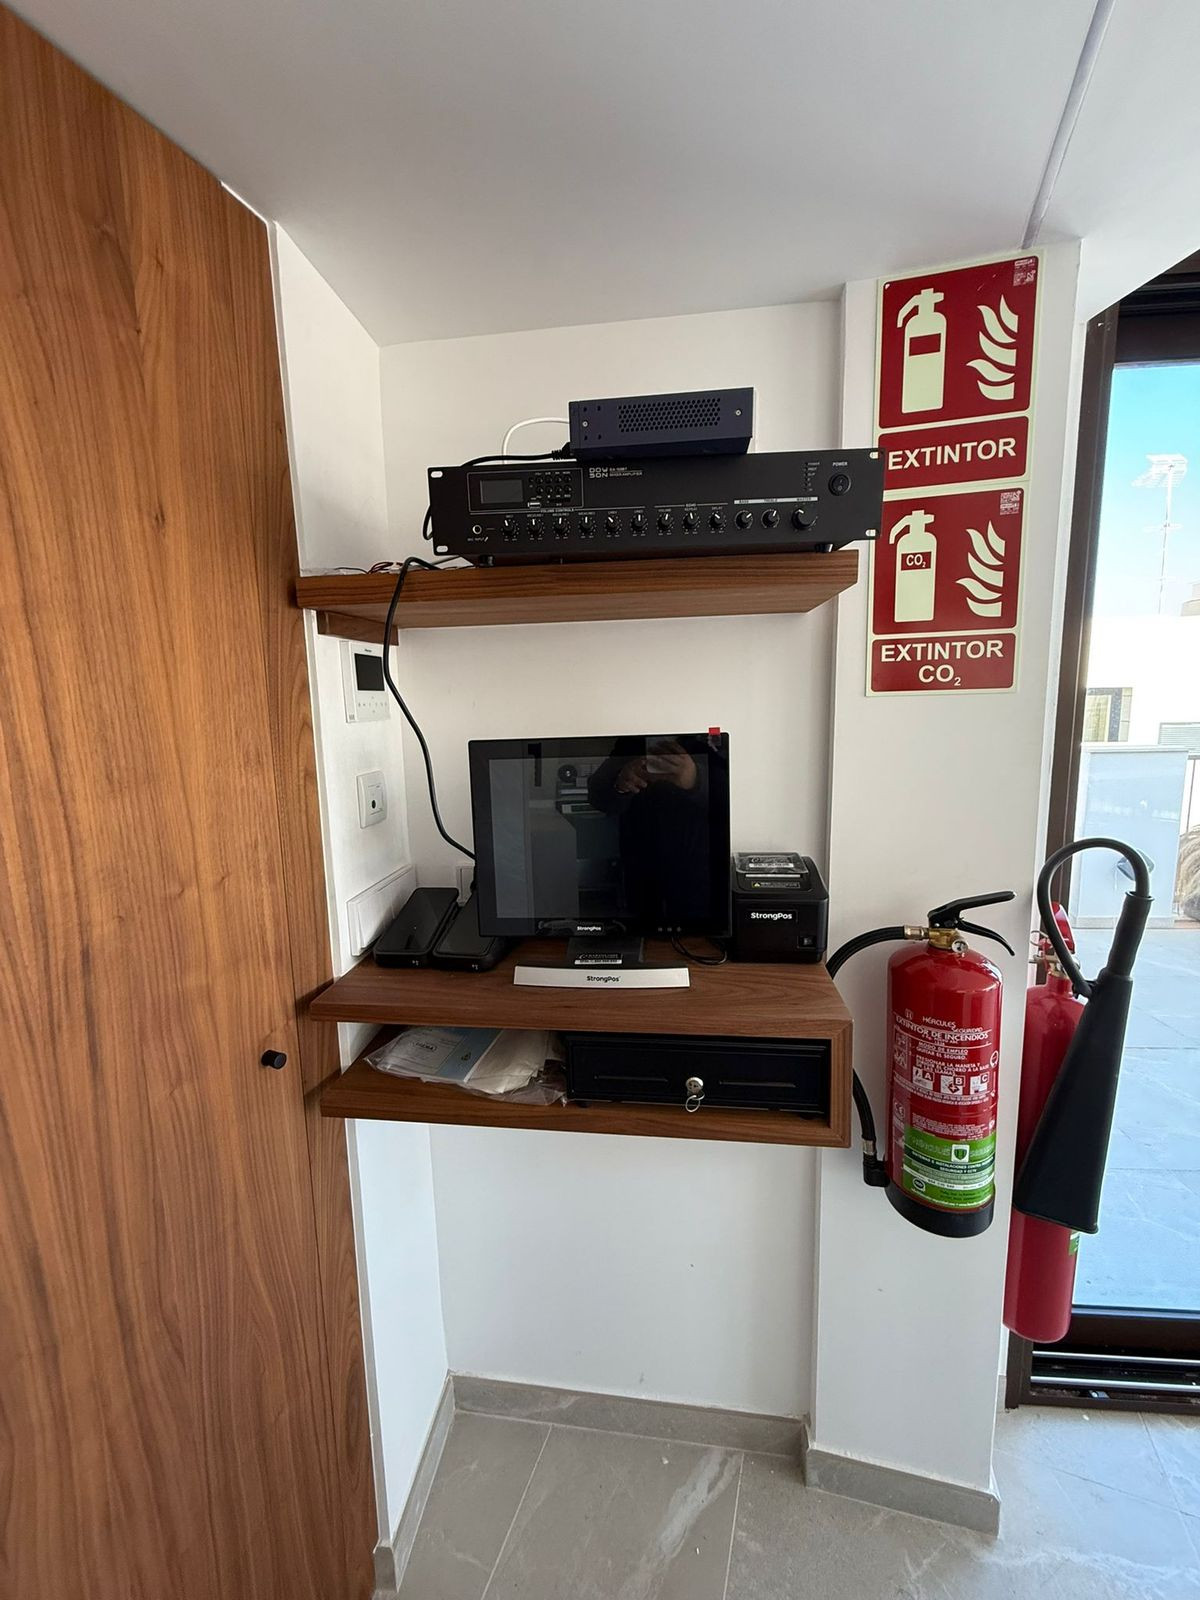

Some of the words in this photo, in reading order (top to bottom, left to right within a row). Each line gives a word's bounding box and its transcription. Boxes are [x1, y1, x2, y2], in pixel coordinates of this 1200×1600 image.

[888, 437, 1017, 471] EXTINTOR
[906, 554, 926, 568] CO2
[881, 640, 1004, 662] EXTINTOR
[918, 664, 961, 686] CO2
[750, 912, 792, 920] StrongPos
[945, 1032, 988, 1041] INCENDIOS
[925, 1072, 932, 1080] A
